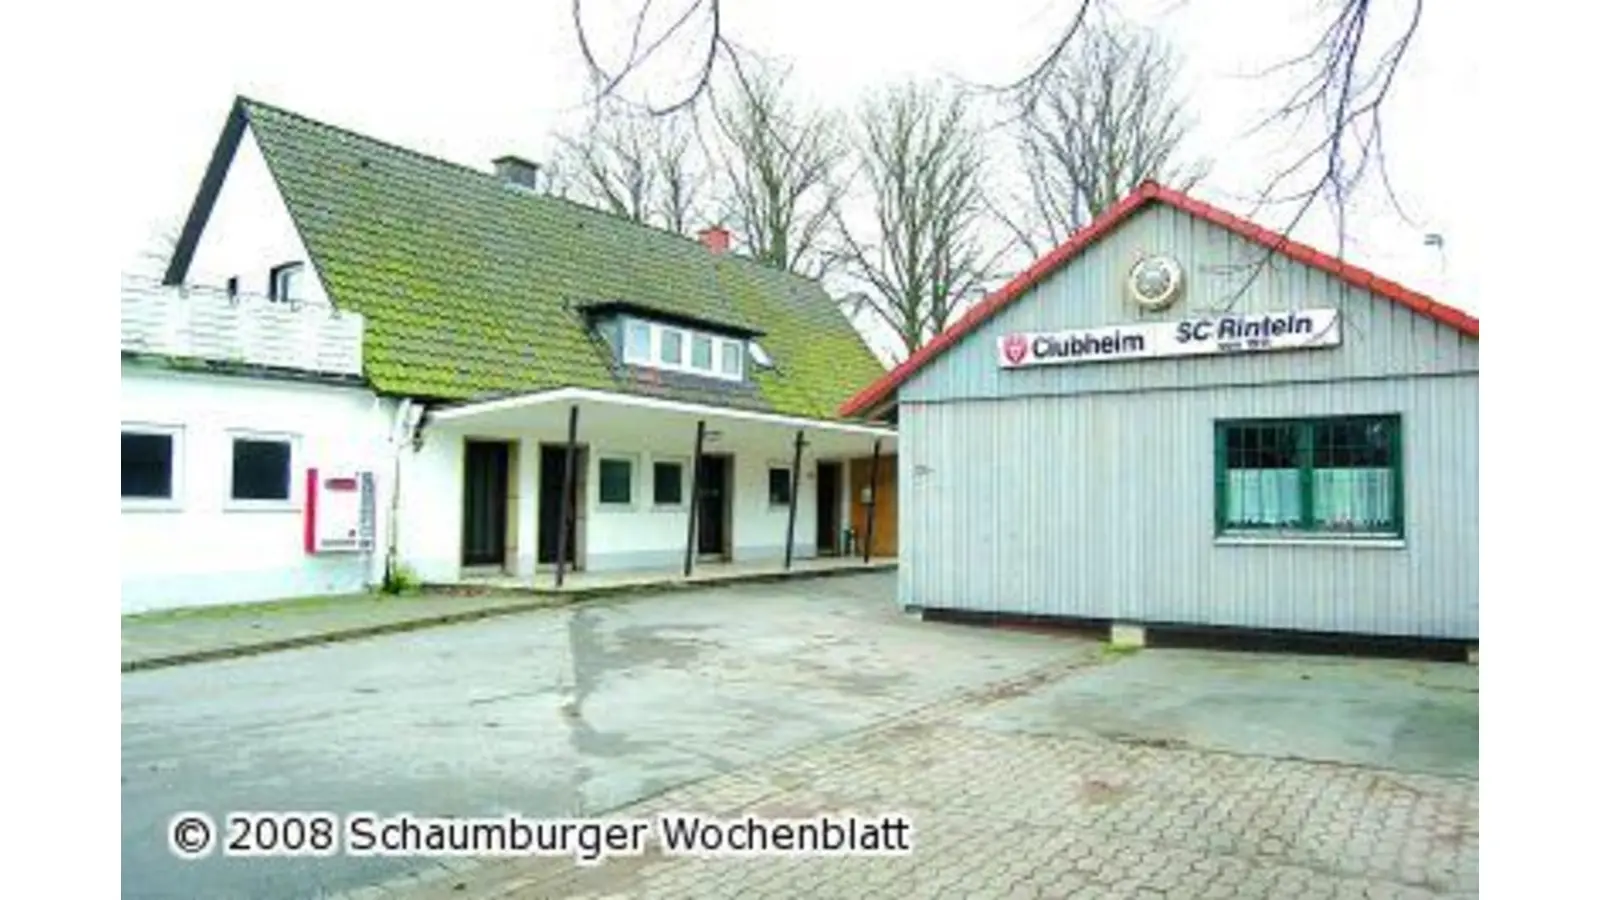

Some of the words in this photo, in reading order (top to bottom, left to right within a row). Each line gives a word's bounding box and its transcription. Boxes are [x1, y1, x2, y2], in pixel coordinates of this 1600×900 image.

[1032, 330, 1145, 359] Clubheim
[1176, 321, 1212, 344] SC
[1217, 314, 1312, 340] Rinteln
